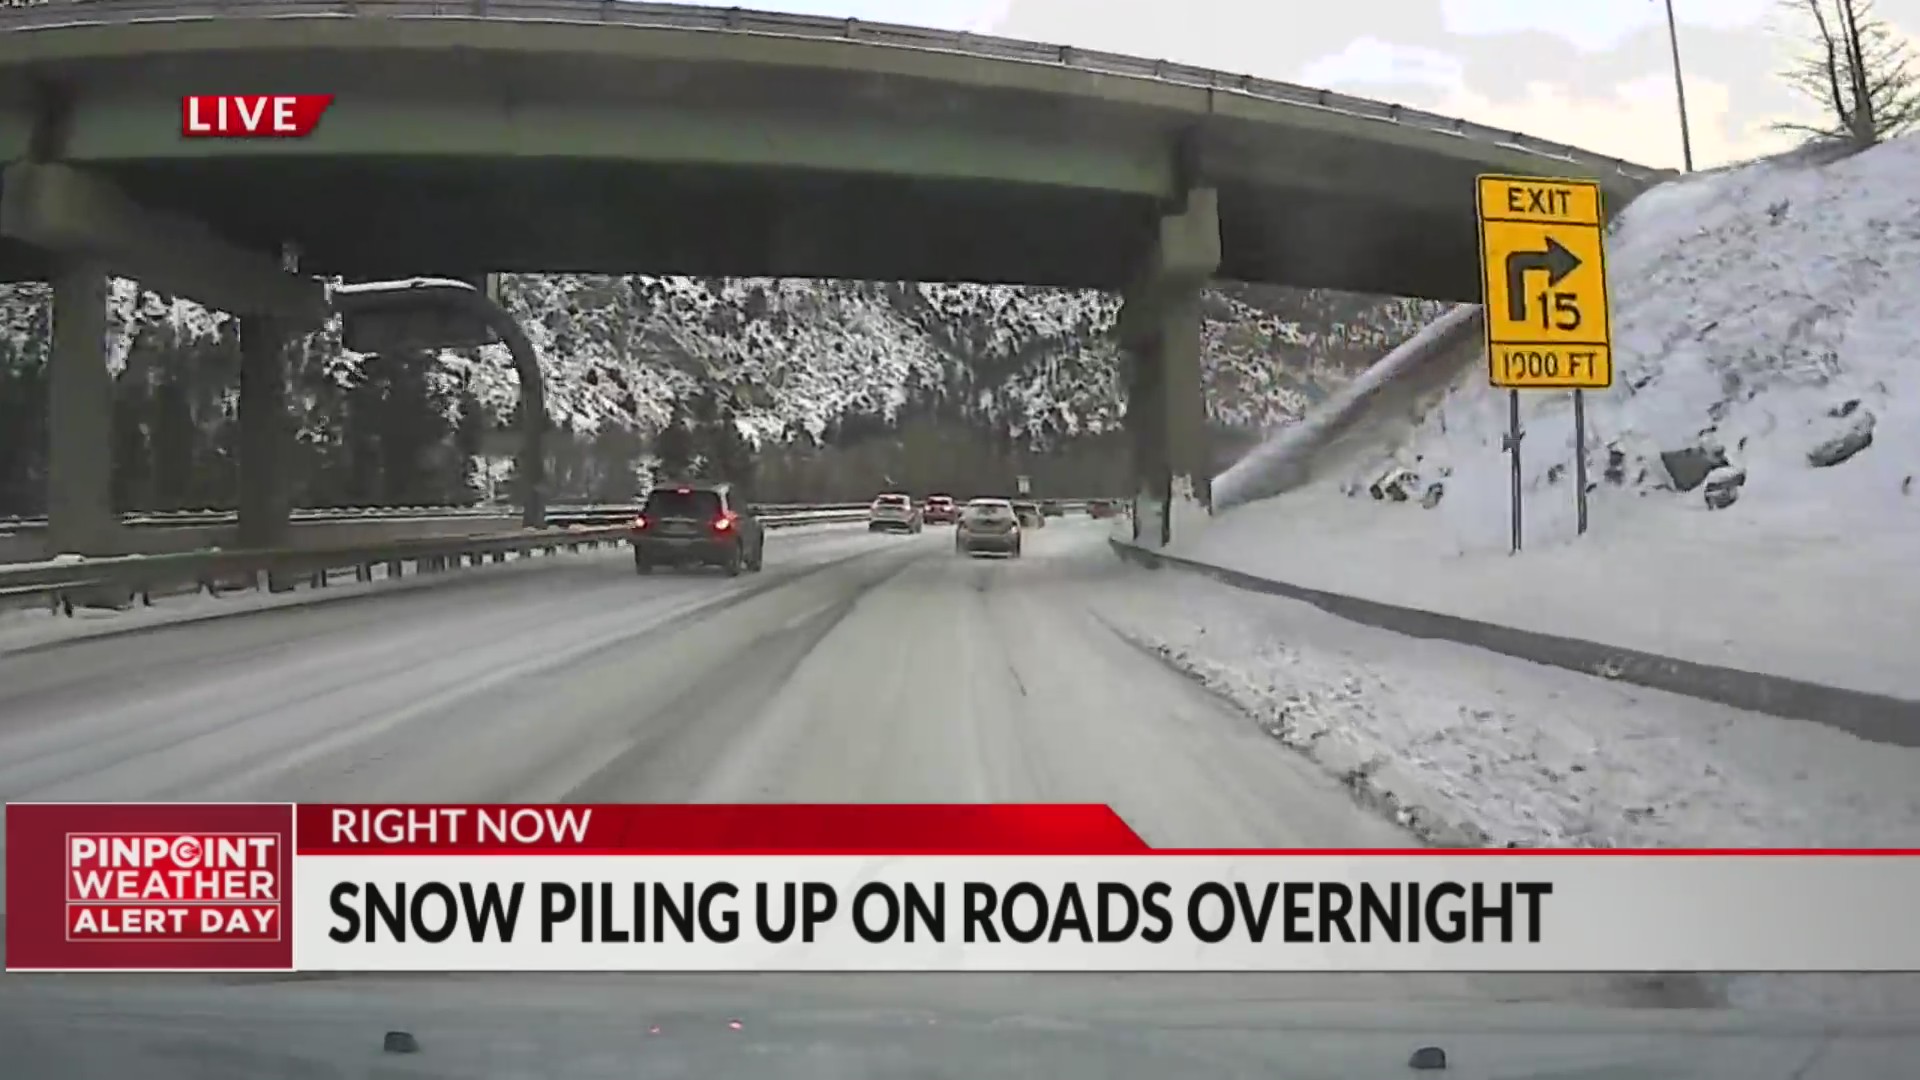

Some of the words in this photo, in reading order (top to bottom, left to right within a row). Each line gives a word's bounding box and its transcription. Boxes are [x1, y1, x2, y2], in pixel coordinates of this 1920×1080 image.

[1508, 187, 1571, 215] EXIT
[1537, 291, 1581, 331] 15
[1504, 351, 1559, 380] 1000
[1568, 351, 1597, 380] FT
